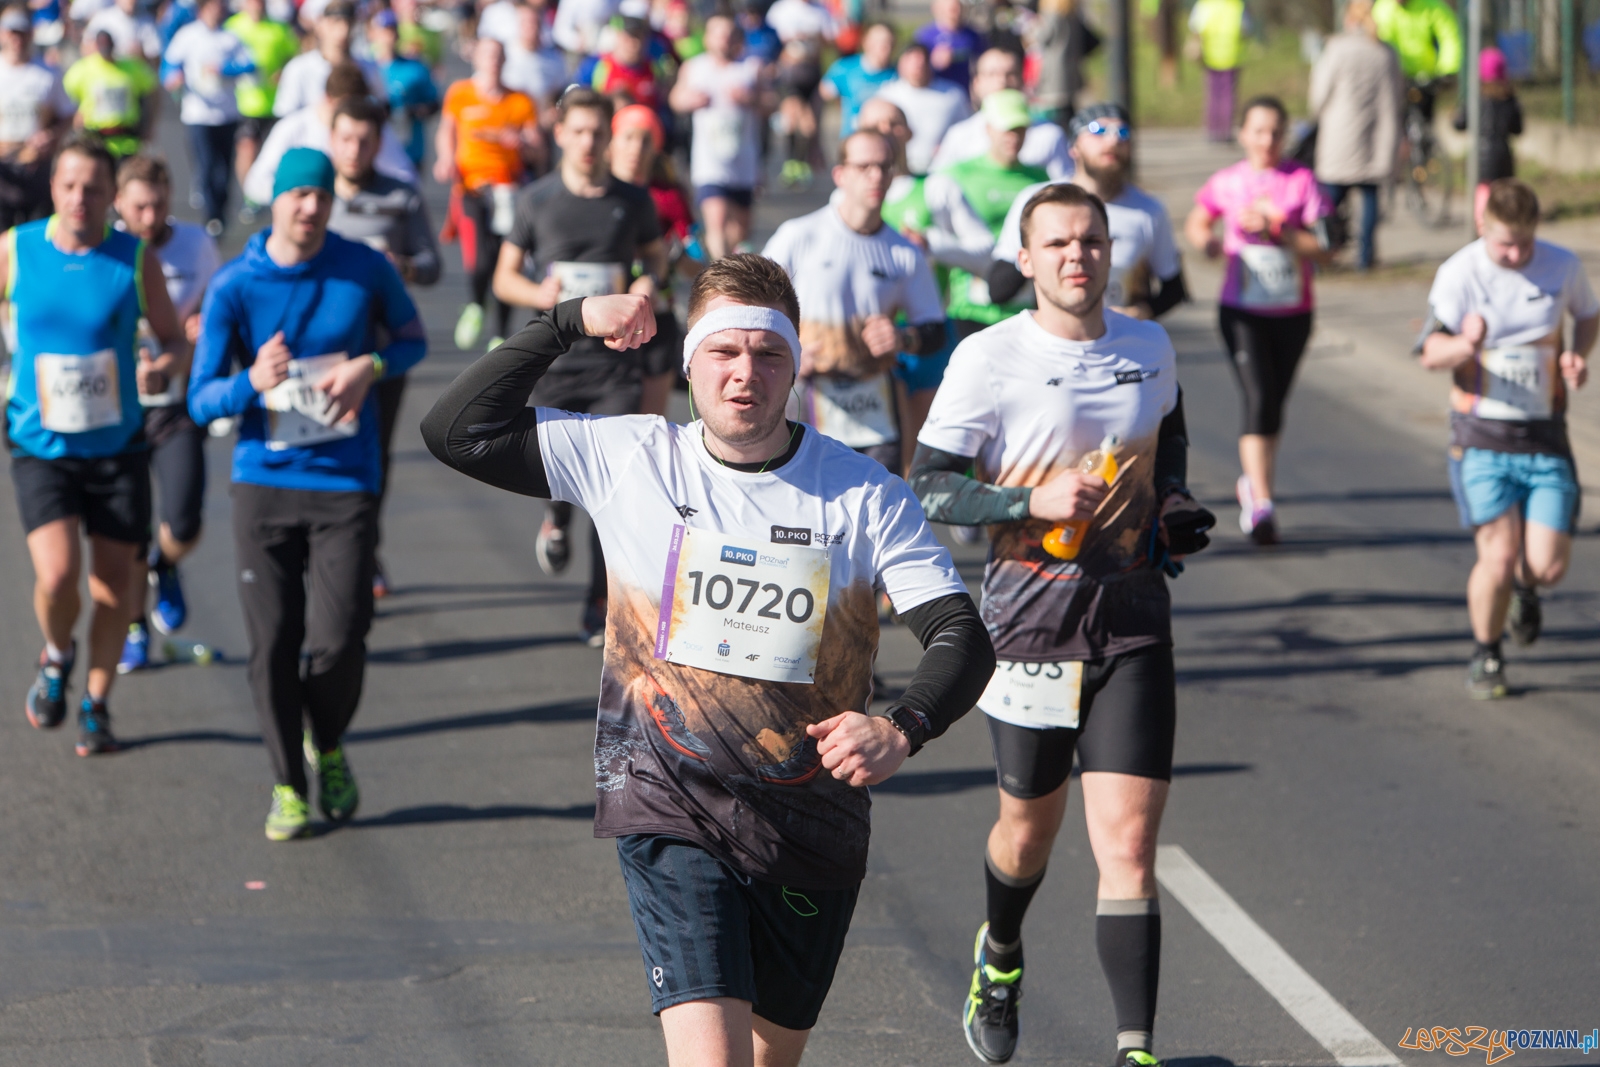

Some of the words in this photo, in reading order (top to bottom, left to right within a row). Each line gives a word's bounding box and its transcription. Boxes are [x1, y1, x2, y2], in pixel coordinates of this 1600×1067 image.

[774, 530, 787, 539] 10.
[788, 531, 808, 541] PKO
[724, 550, 735, 559] 10.
[736, 552, 754, 562] PKO
[688, 571, 814, 623] 10720
[723, 617, 770, 634] Mateusz
[745, 653, 760, 662] 4F
